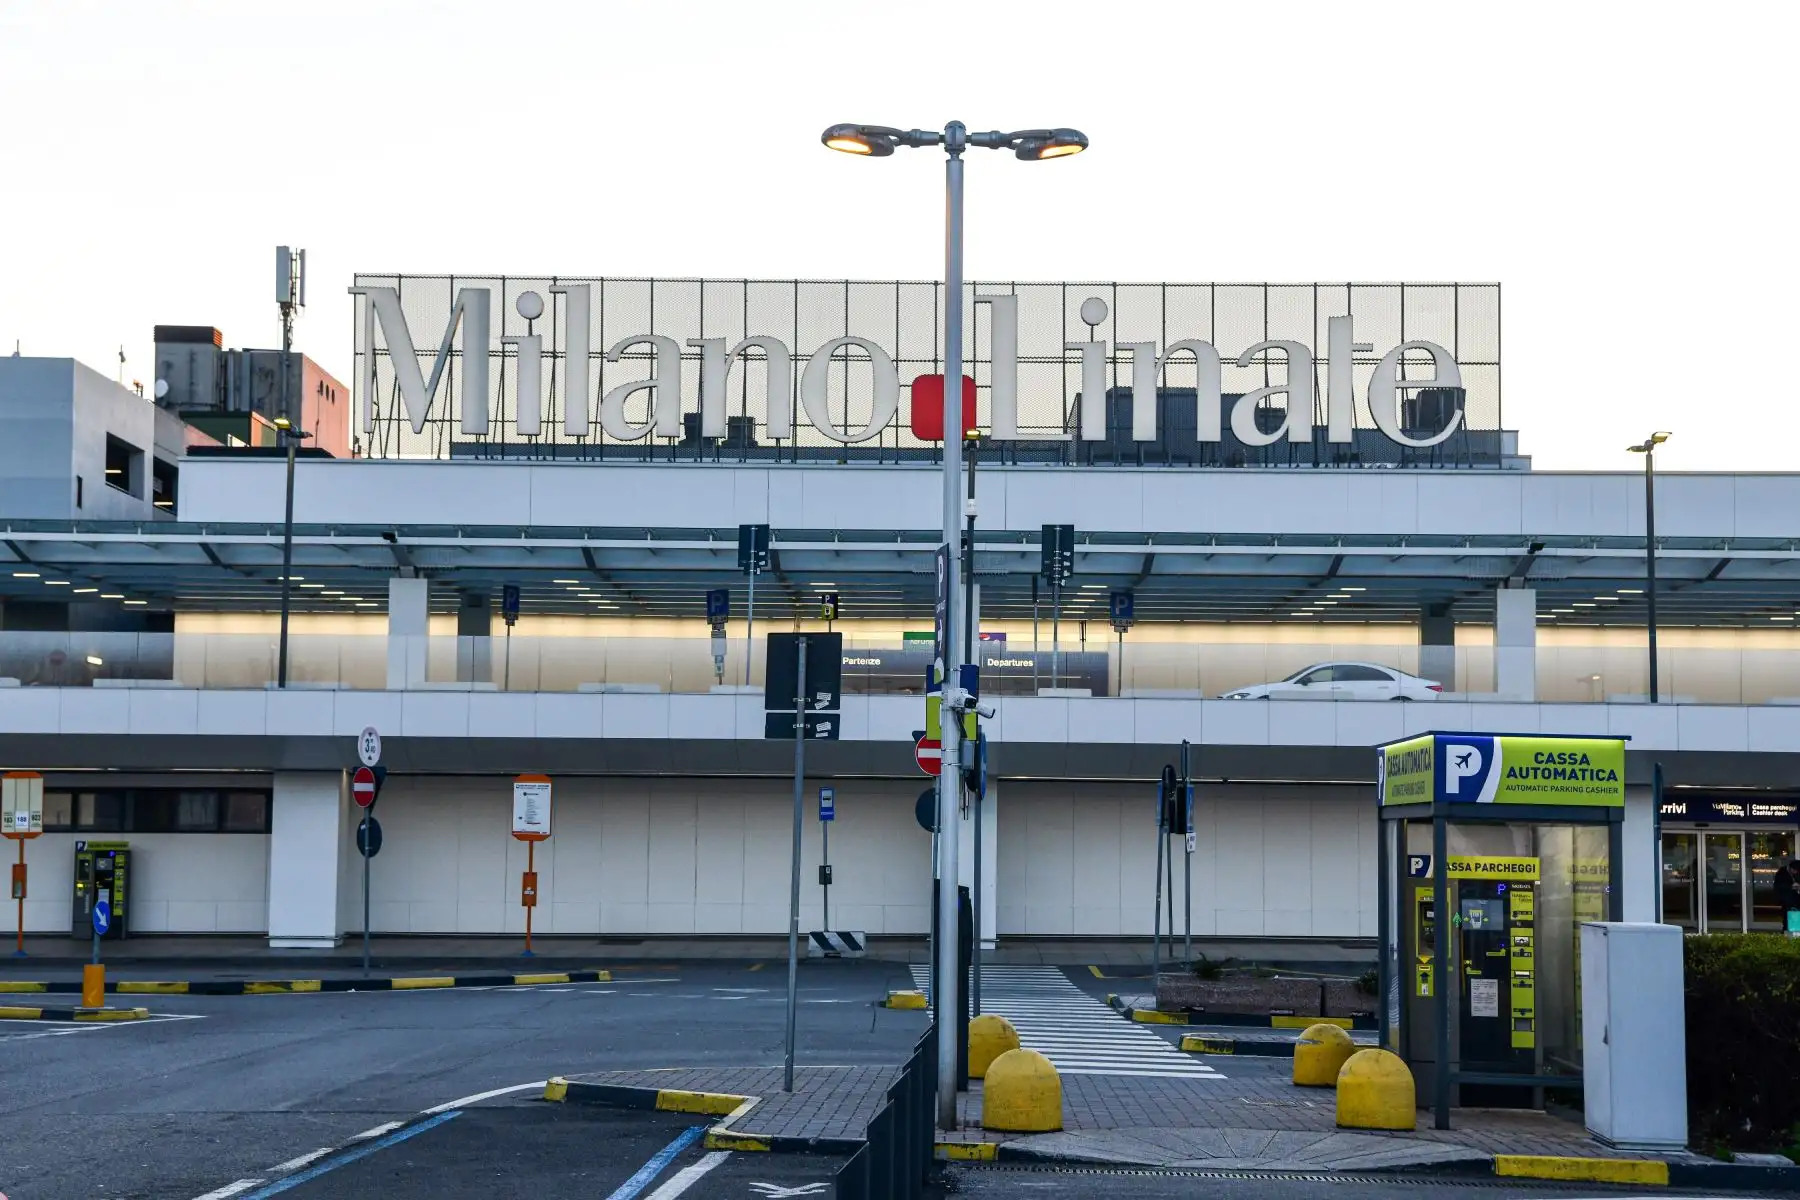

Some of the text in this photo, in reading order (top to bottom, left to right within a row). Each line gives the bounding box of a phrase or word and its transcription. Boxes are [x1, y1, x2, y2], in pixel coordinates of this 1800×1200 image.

[348, 283, 1464, 447] Milano Linate
[938, 555, 944, 598] P
[1115, 595, 1129, 615] P
[842, 656, 881, 666] Partenze
[987, 657, 1034, 668] Departures
[1387, 746, 1432, 778] CASSA AUTOMATICA
[1534, 752, 1591, 766] CASSA
[1445, 744, 1482, 794] P
[1506, 767, 1619, 783] AUTOMATICA
[1505, 784, 1619, 794] AUTOMATIC PARKING CASHIER
[1660, 803, 1687, 814] rrivi
[1411, 857, 1424, 875] P
[1446, 862, 1536, 873] ASSA PARCHEGGI
[1497, 883, 1506, 895] P
